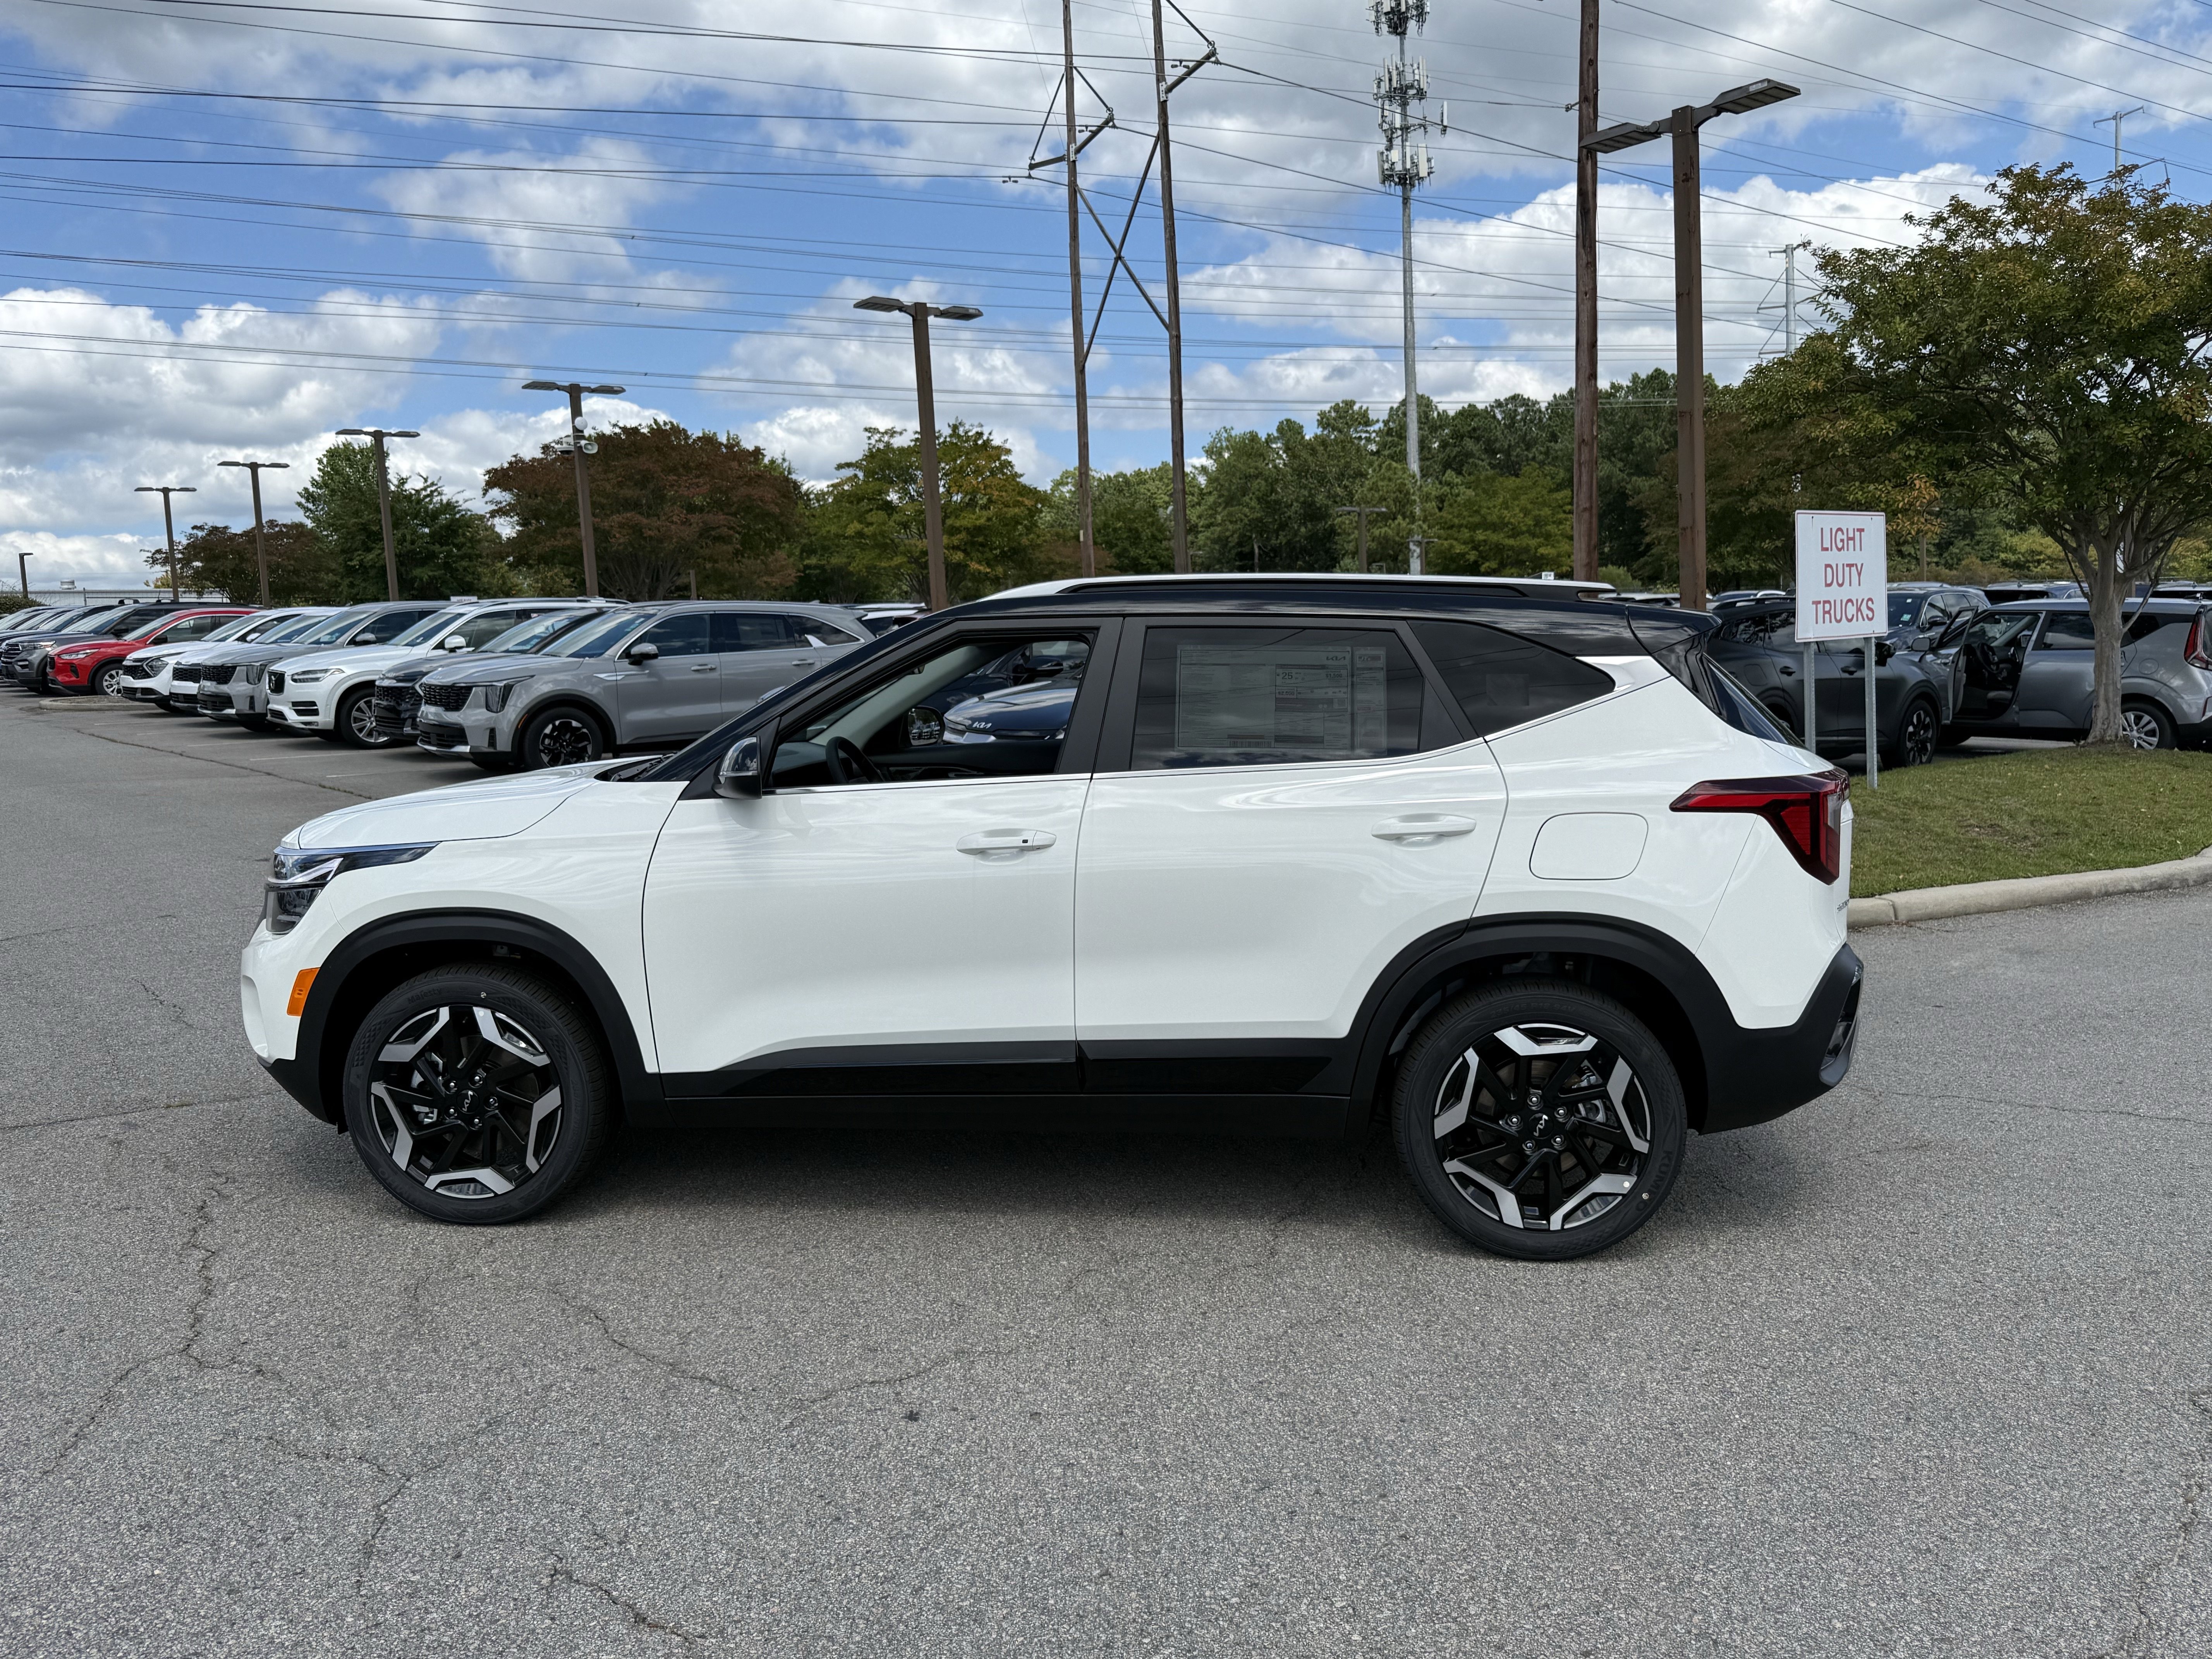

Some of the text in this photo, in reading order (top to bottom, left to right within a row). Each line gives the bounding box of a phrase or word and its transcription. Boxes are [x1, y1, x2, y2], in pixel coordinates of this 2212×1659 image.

[1820, 527, 1865, 552] LIGHT
[1824, 563, 1863, 588] DUTY
[1812, 597, 1875, 625] TRUCKS
[407, 987, 443, 1005] Majesty
[462, 1091, 473, 1111] KIA
[1534, 1115, 1548, 1136] KIA
